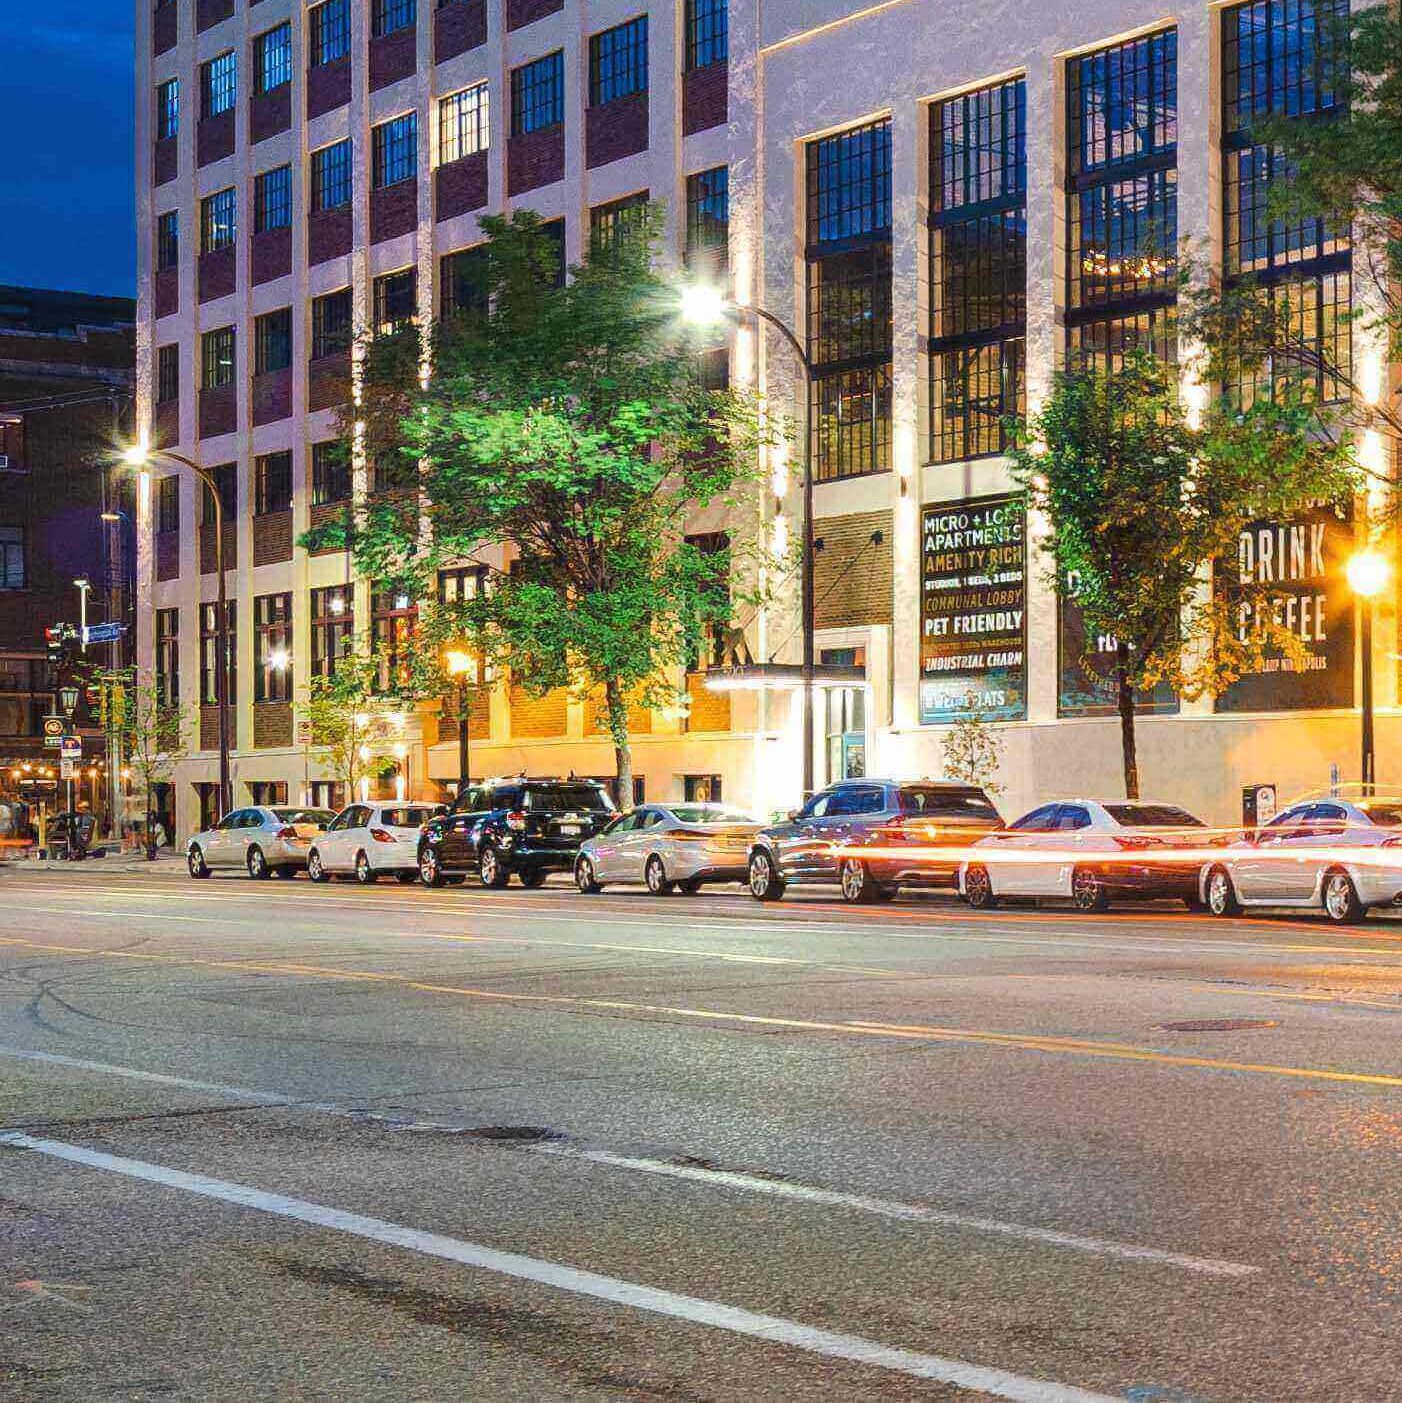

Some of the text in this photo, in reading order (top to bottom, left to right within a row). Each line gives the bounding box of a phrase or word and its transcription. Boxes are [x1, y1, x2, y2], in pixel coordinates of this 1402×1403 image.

[924, 514, 969, 534] MICRO
[925, 524, 1022, 552] APARTMENTS
[926, 545, 1022, 574] AMENITY RICH
[1238, 522, 1326, 585] DRINK
[926, 589, 1023, 612] COMMUNAL LOBBY
[925, 610, 1023, 638] PET FRIENDLY
[925, 651, 1023, 673] INDUSTRIAL CHARM
